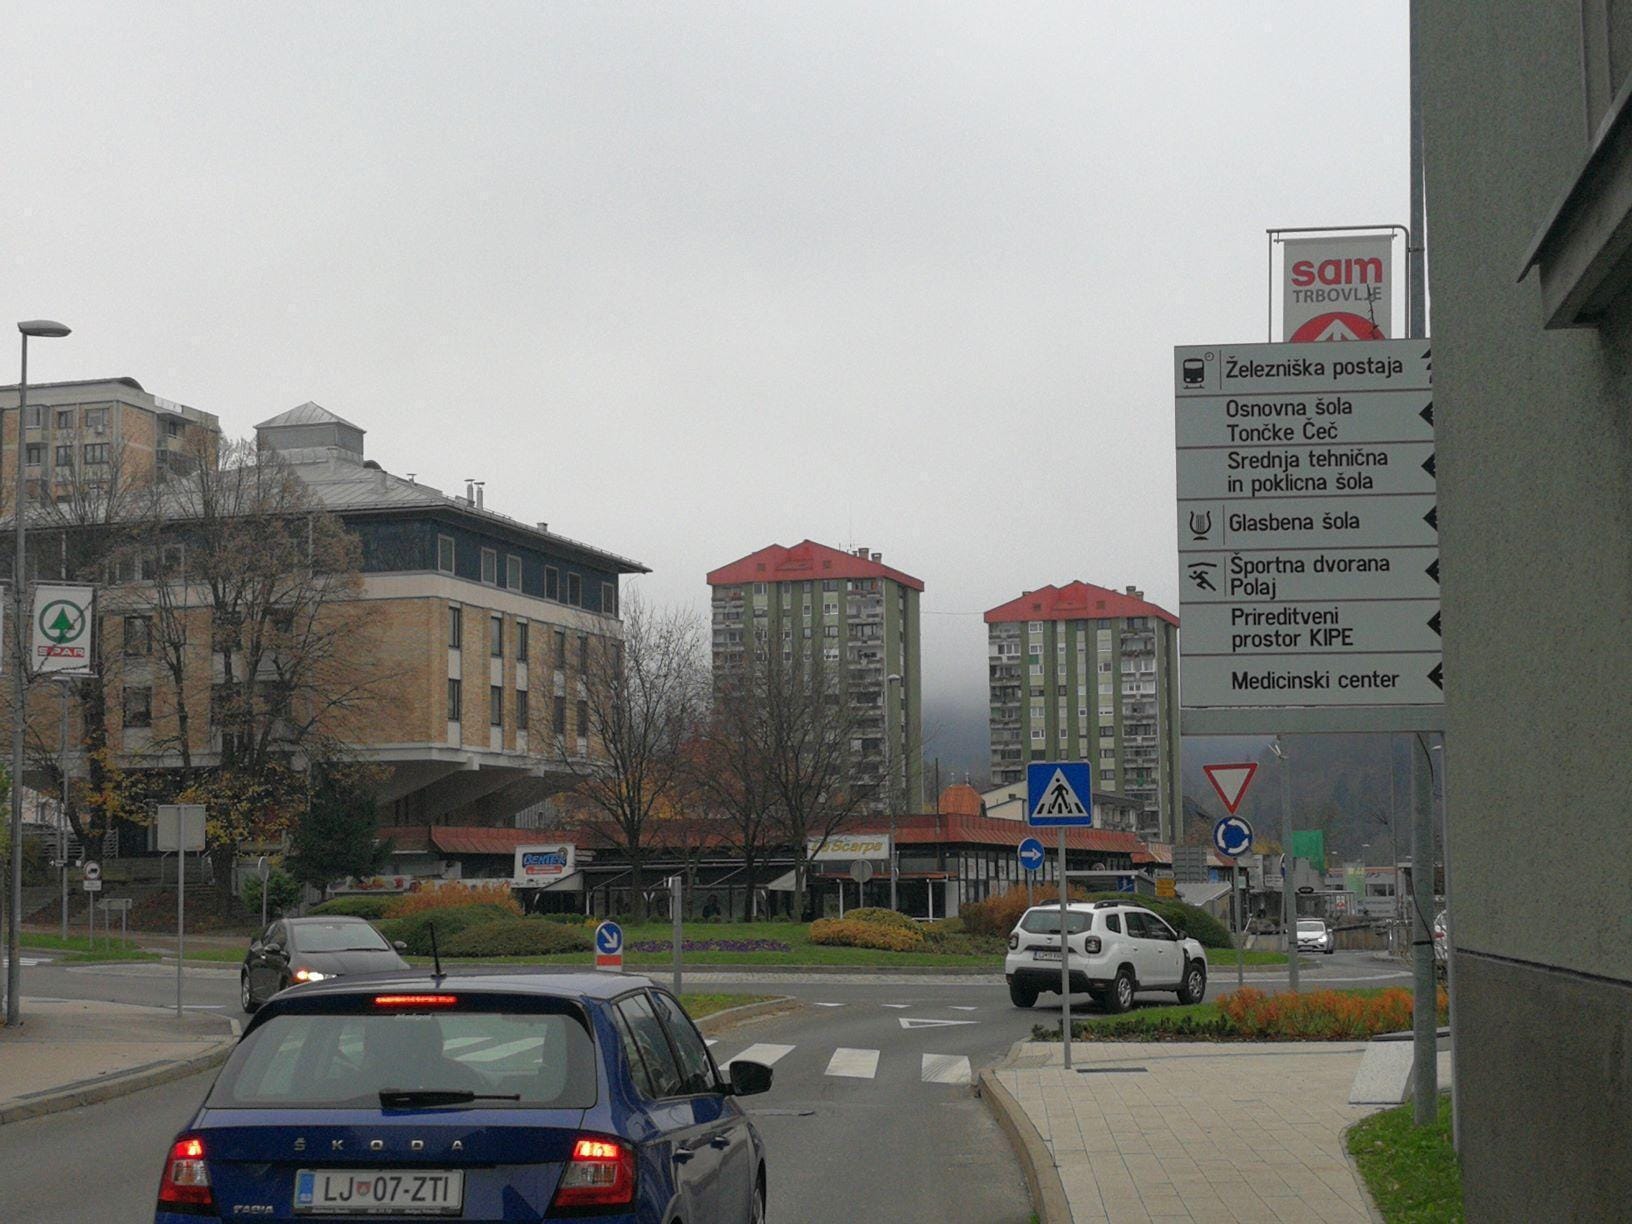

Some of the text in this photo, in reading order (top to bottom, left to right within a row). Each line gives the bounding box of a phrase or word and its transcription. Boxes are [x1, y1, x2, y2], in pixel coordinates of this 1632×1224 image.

[1291, 257, 1383, 287] sam
[1292, 286, 1382, 304] TRBOVLJE
[1225, 355, 1403, 380] Železniška postaja
[1226, 397, 1353, 418] Osnovna šola
[1227, 417, 1338, 442] Tončke Čeč
[1227, 448, 1389, 473] Srednja tehnična
[1227, 472, 1374, 498] in poklicna šola
[1229, 511, 1360, 532] Glasbena šola
[1230, 552, 1390, 578] Športna dvorana
[1230, 577, 1277, 600] Polaj
[1231, 606, 1340, 626] Prireditveni
[37, 646, 85, 657] SPAR
[1231, 628, 1354, 652] prostor KIPE
[1231, 670, 1400, 690] Medicinski center
[324, 1176, 449, 1202] LJ 07-ZTI
